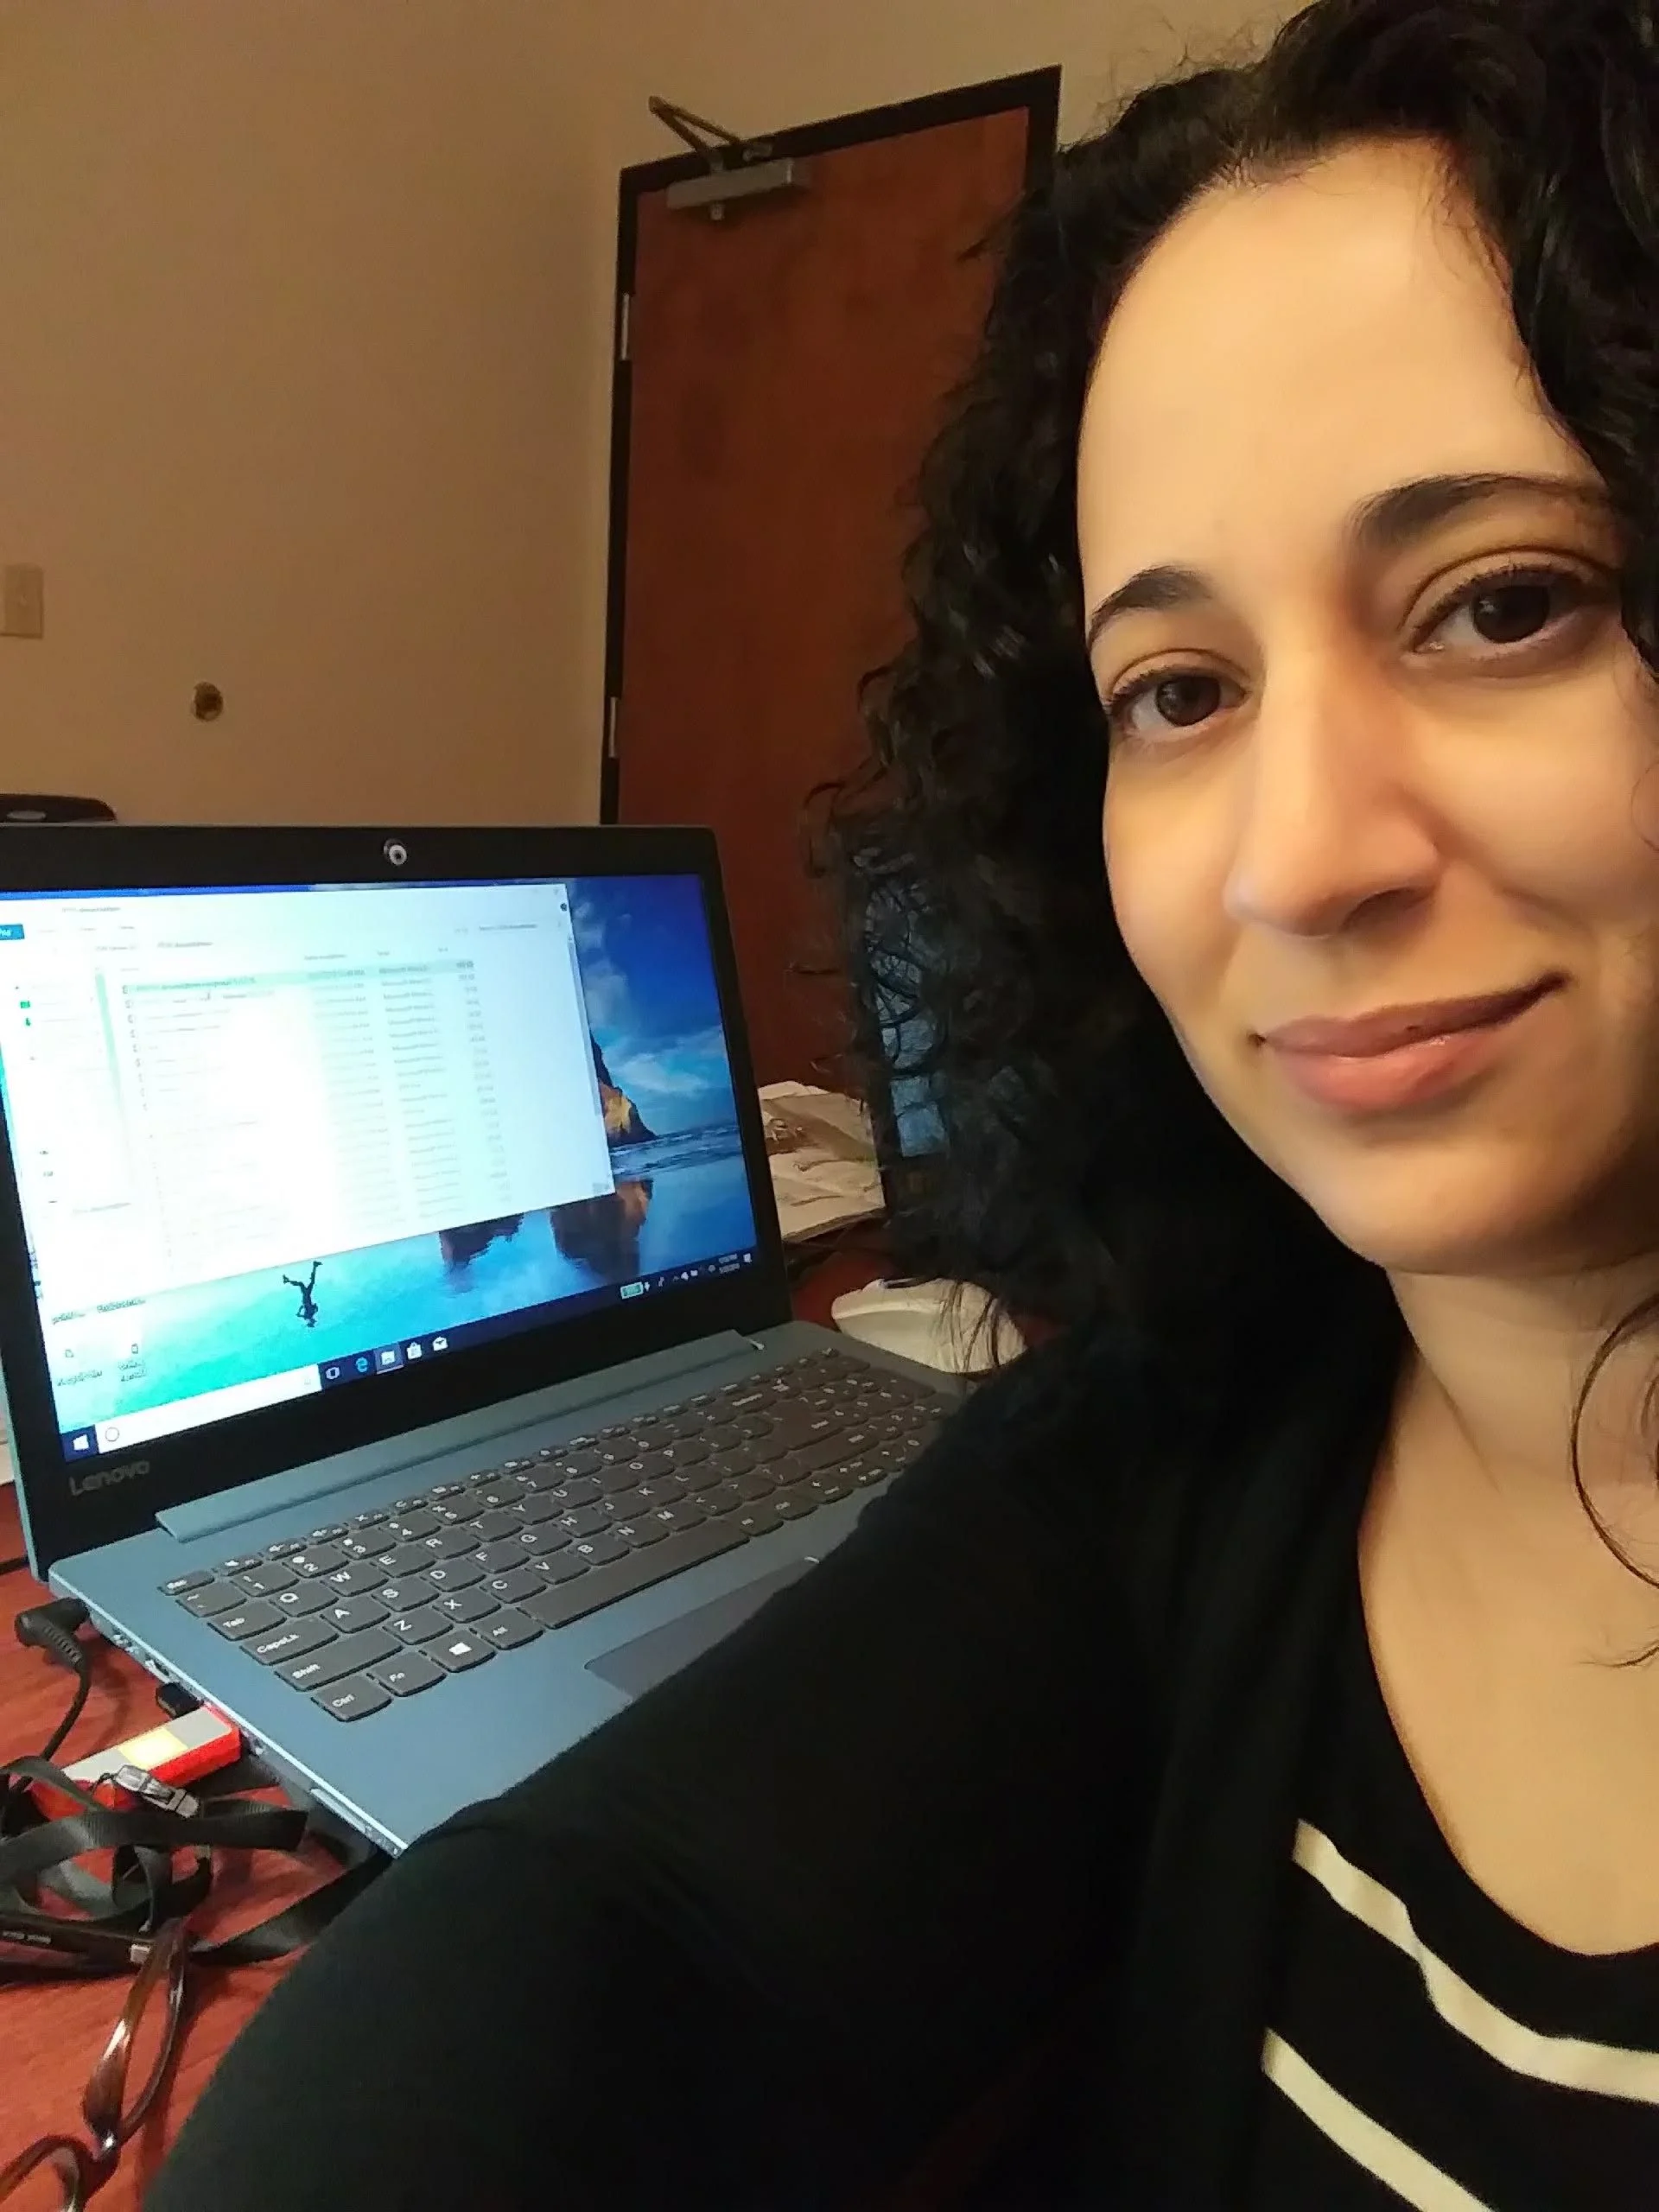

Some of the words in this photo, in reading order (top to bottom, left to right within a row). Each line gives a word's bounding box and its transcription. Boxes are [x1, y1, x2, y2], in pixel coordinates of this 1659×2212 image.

[68, 1460, 150, 1497] Lenovo
[552, 1489, 568, 1497] U
[512, 1503, 526, 1512] Y
[656, 1510, 675, 1521] M
[470, 1520, 484, 1529] T
[561, 1516, 578, 1527] H
[617, 1526, 635, 1536] N
[425, 1538, 442, 1548] R
[520, 1534, 537, 1544] G
[577, 1544, 594, 1554] B
[378, 1554, 397, 1565] E
[475, 1552, 488, 1561] F
[534, 1561, 550, 1571] V
[330, 1571, 352, 1583] W
[429, 1570, 446, 1580] D
[492, 1580, 508, 1590] C
[382, 1588, 400, 1599] S
[443, 1599, 462, 1611] X
[334, 1609, 350, 1619] A
[222, 1618, 245, 1628] Tab
[394, 1619, 412, 1631] Z
[292, 1663, 321, 1679] Shift
[389, 1672, 405, 1682] Fn
[332, 1694, 355, 1707] Ctrl
